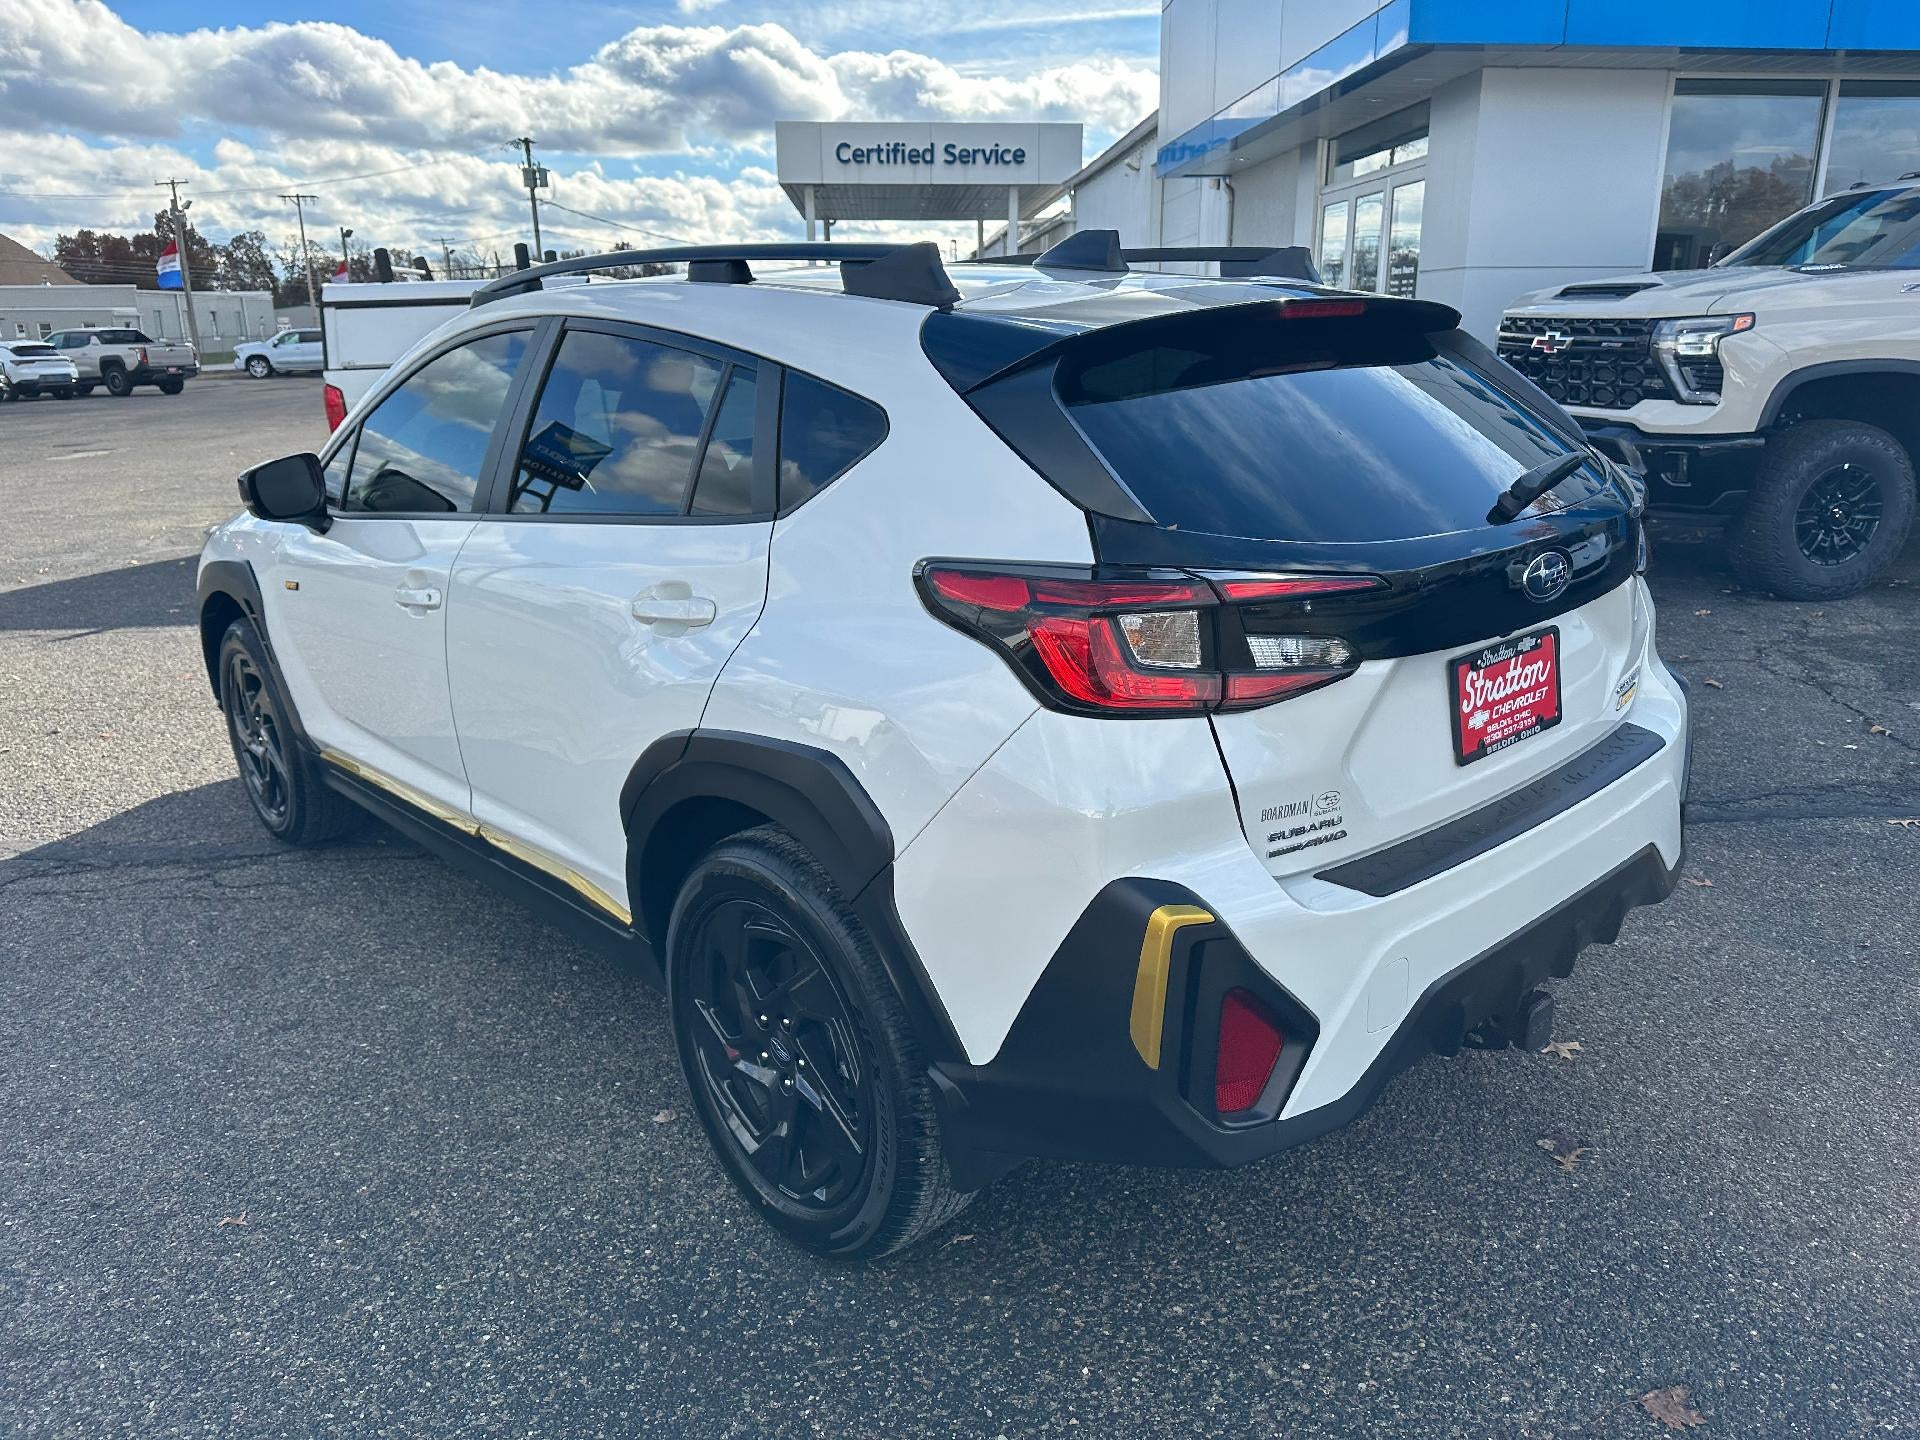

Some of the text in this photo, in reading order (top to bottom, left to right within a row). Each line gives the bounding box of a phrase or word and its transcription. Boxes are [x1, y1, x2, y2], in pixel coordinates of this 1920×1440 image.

[836, 142, 1026, 165] Certified Service
[1481, 644, 1516, 667] Stratton
[1462, 655, 1551, 713] Stratton
[1492, 686, 1549, 719] CHEVROLET
[1514, 709, 1531, 721] OHIO
[1520, 725, 1541, 739] OHIO
[1261, 800, 1309, 822] BOARDMAN
[1267, 815, 1343, 842] SUBARU
